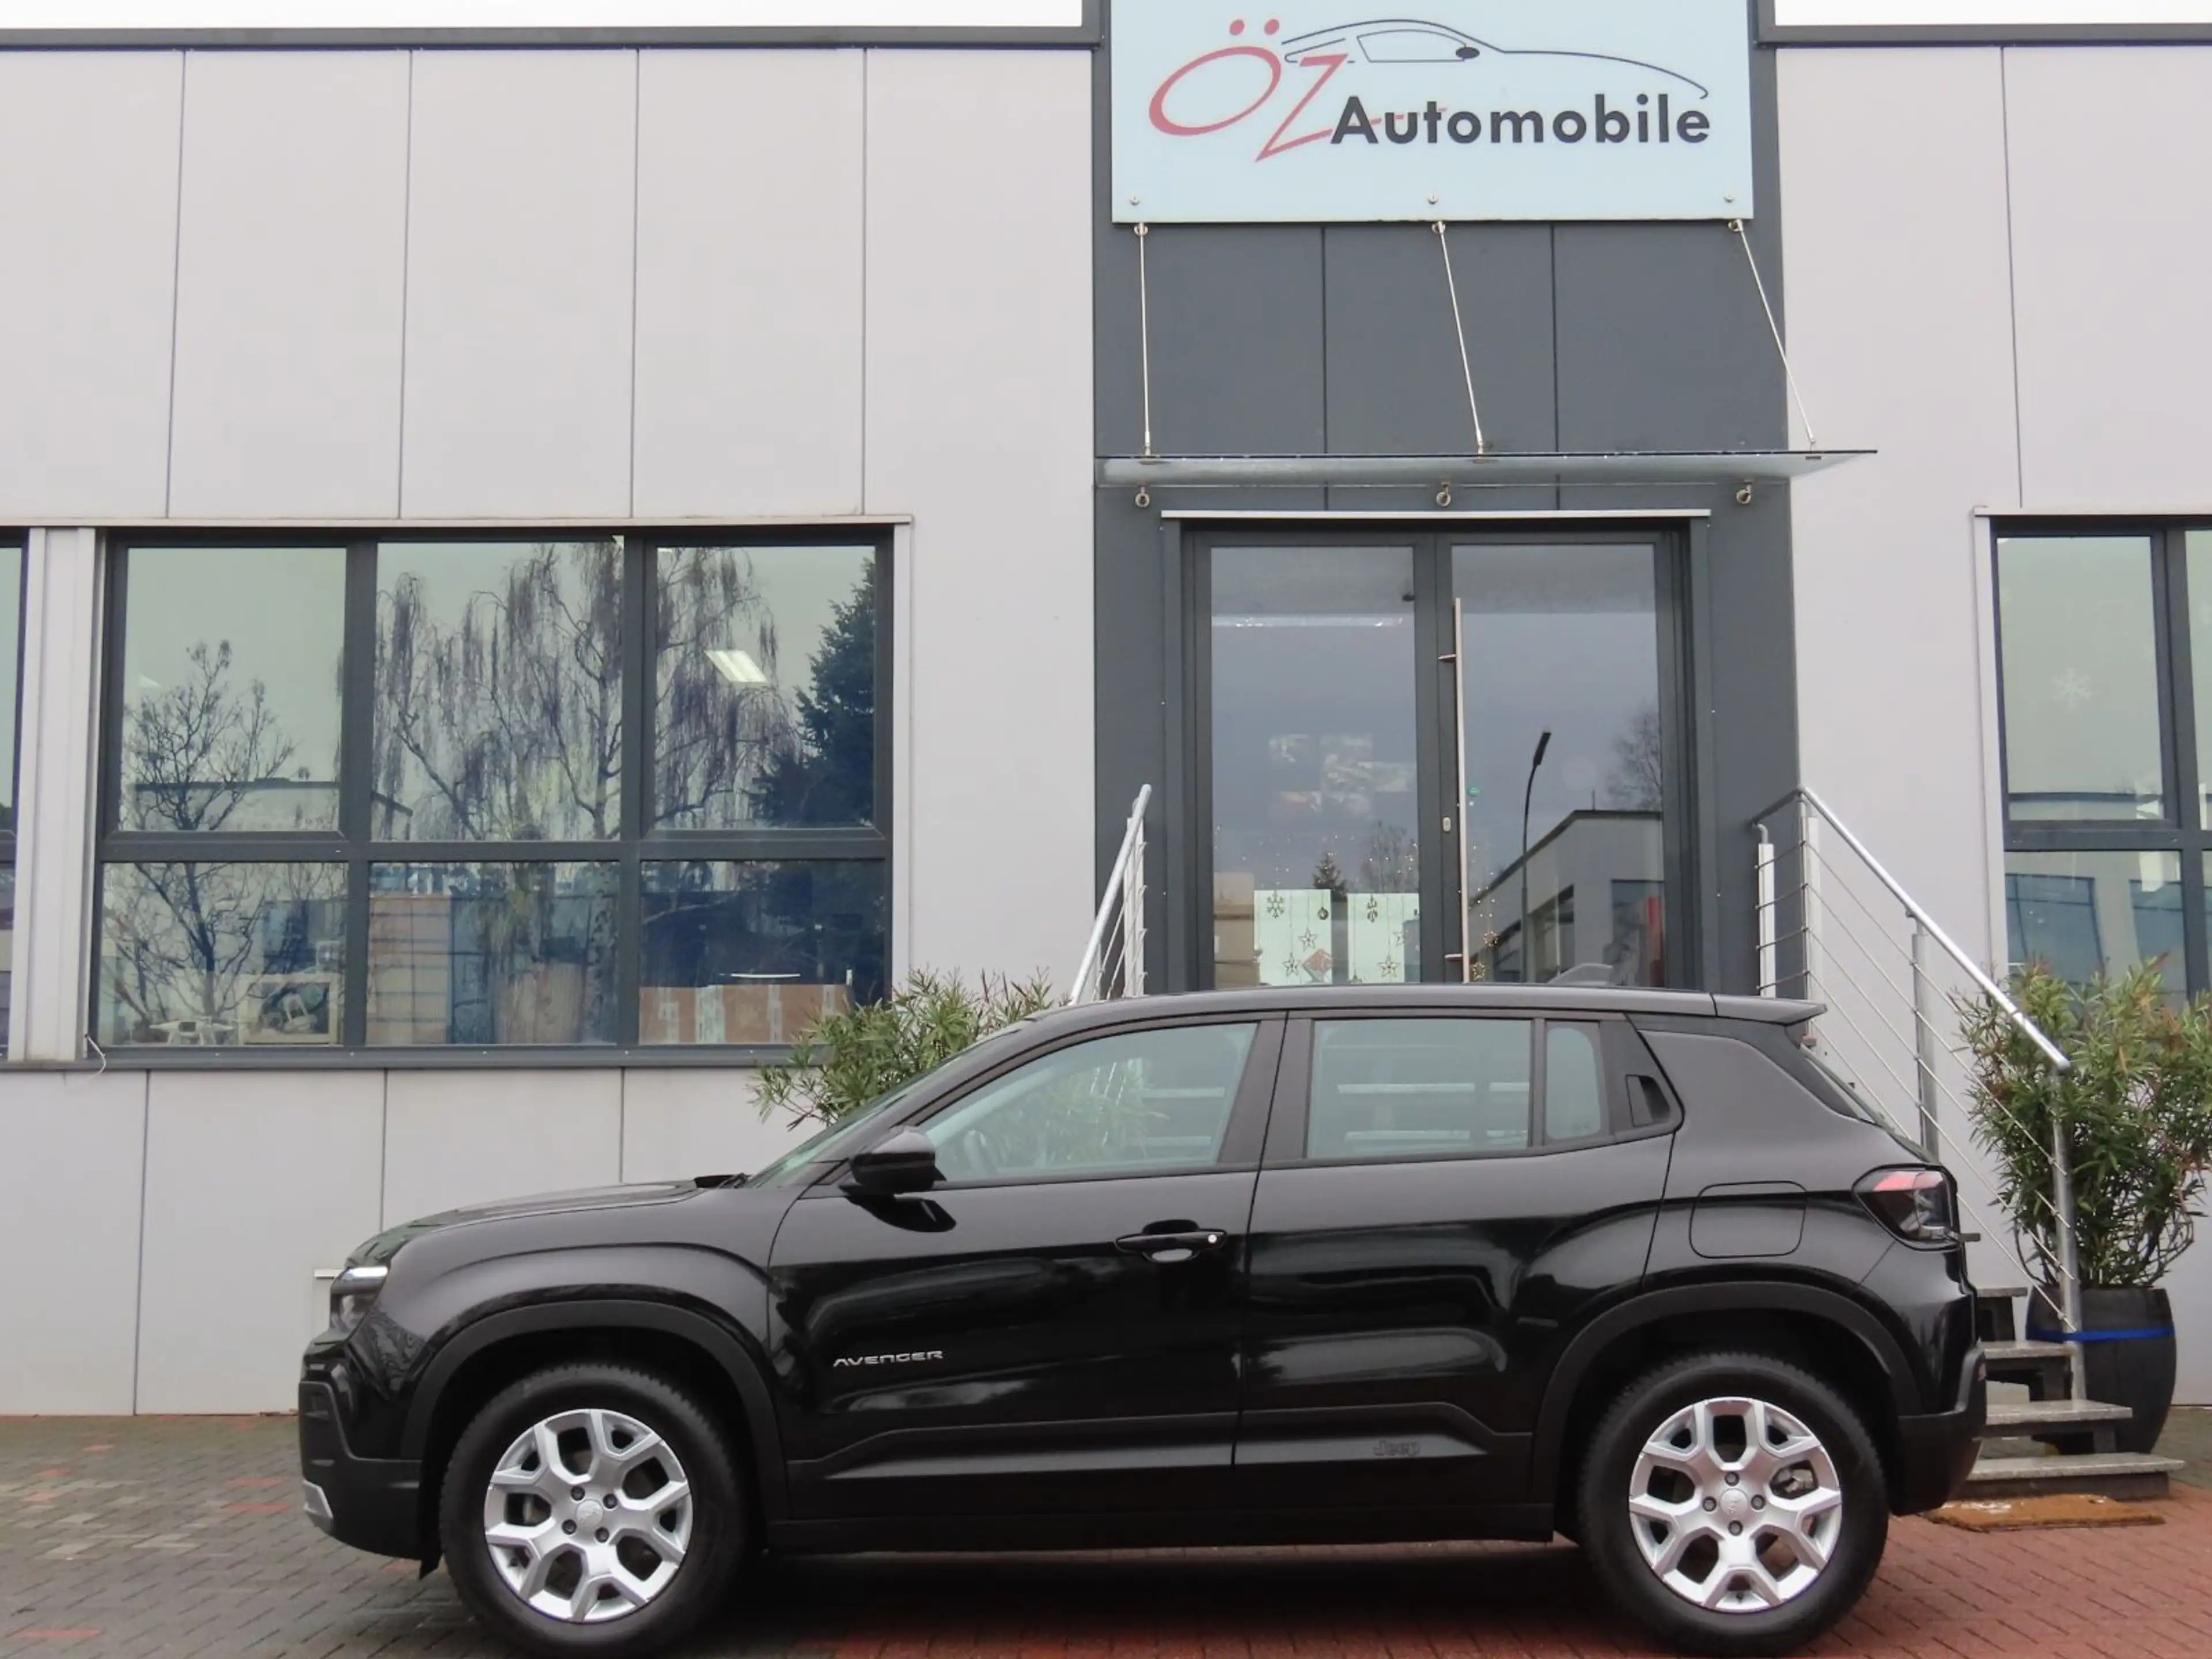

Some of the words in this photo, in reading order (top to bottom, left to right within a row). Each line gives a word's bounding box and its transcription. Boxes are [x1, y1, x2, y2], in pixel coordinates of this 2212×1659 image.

[1149, 19, 1349, 162] ÖZ
[1330, 93, 1710, 143] Automobile
[833, 1350, 943, 1367] AVENGER
